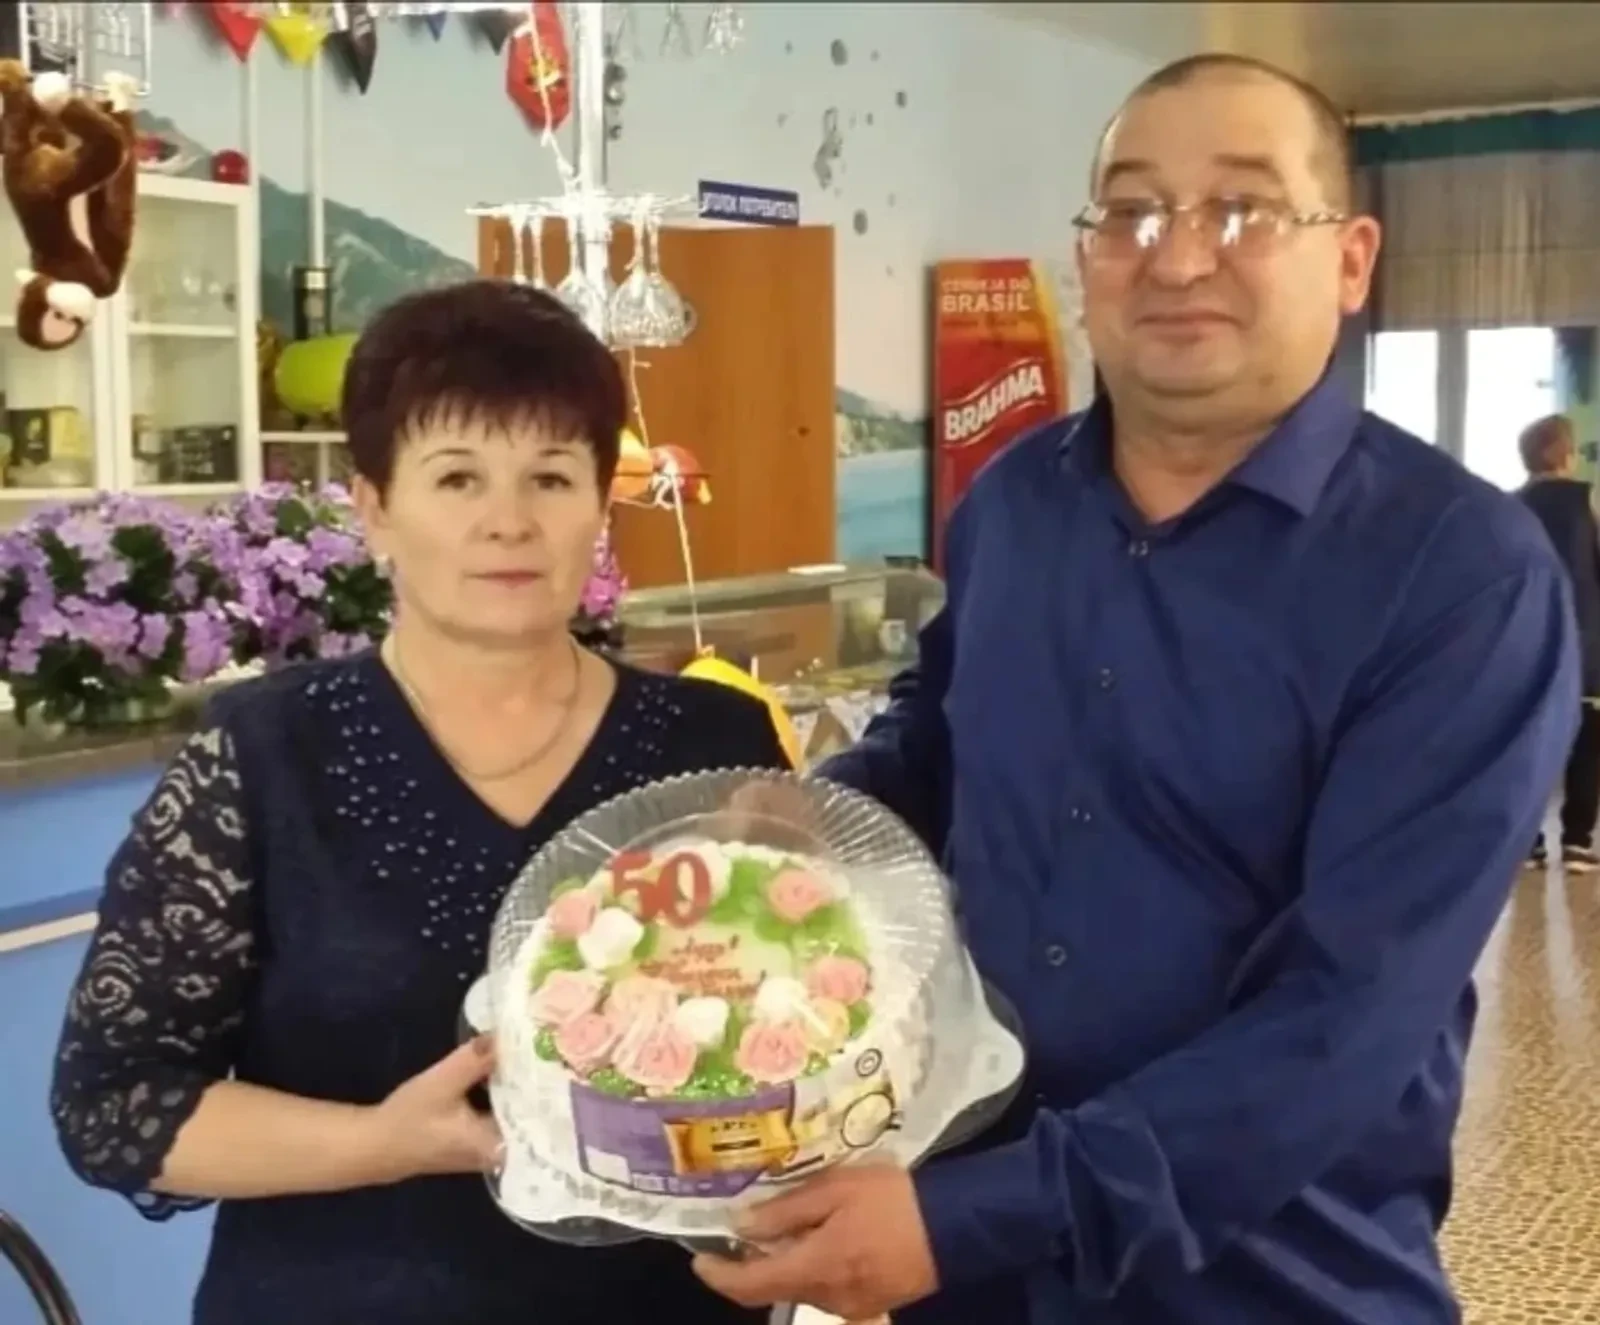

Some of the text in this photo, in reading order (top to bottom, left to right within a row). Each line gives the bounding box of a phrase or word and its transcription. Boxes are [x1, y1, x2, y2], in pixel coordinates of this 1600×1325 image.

[942, 292, 1031, 313] BRASIL
[944, 365, 1046, 441] BRAHMA
[608, 851, 712, 929] 50
